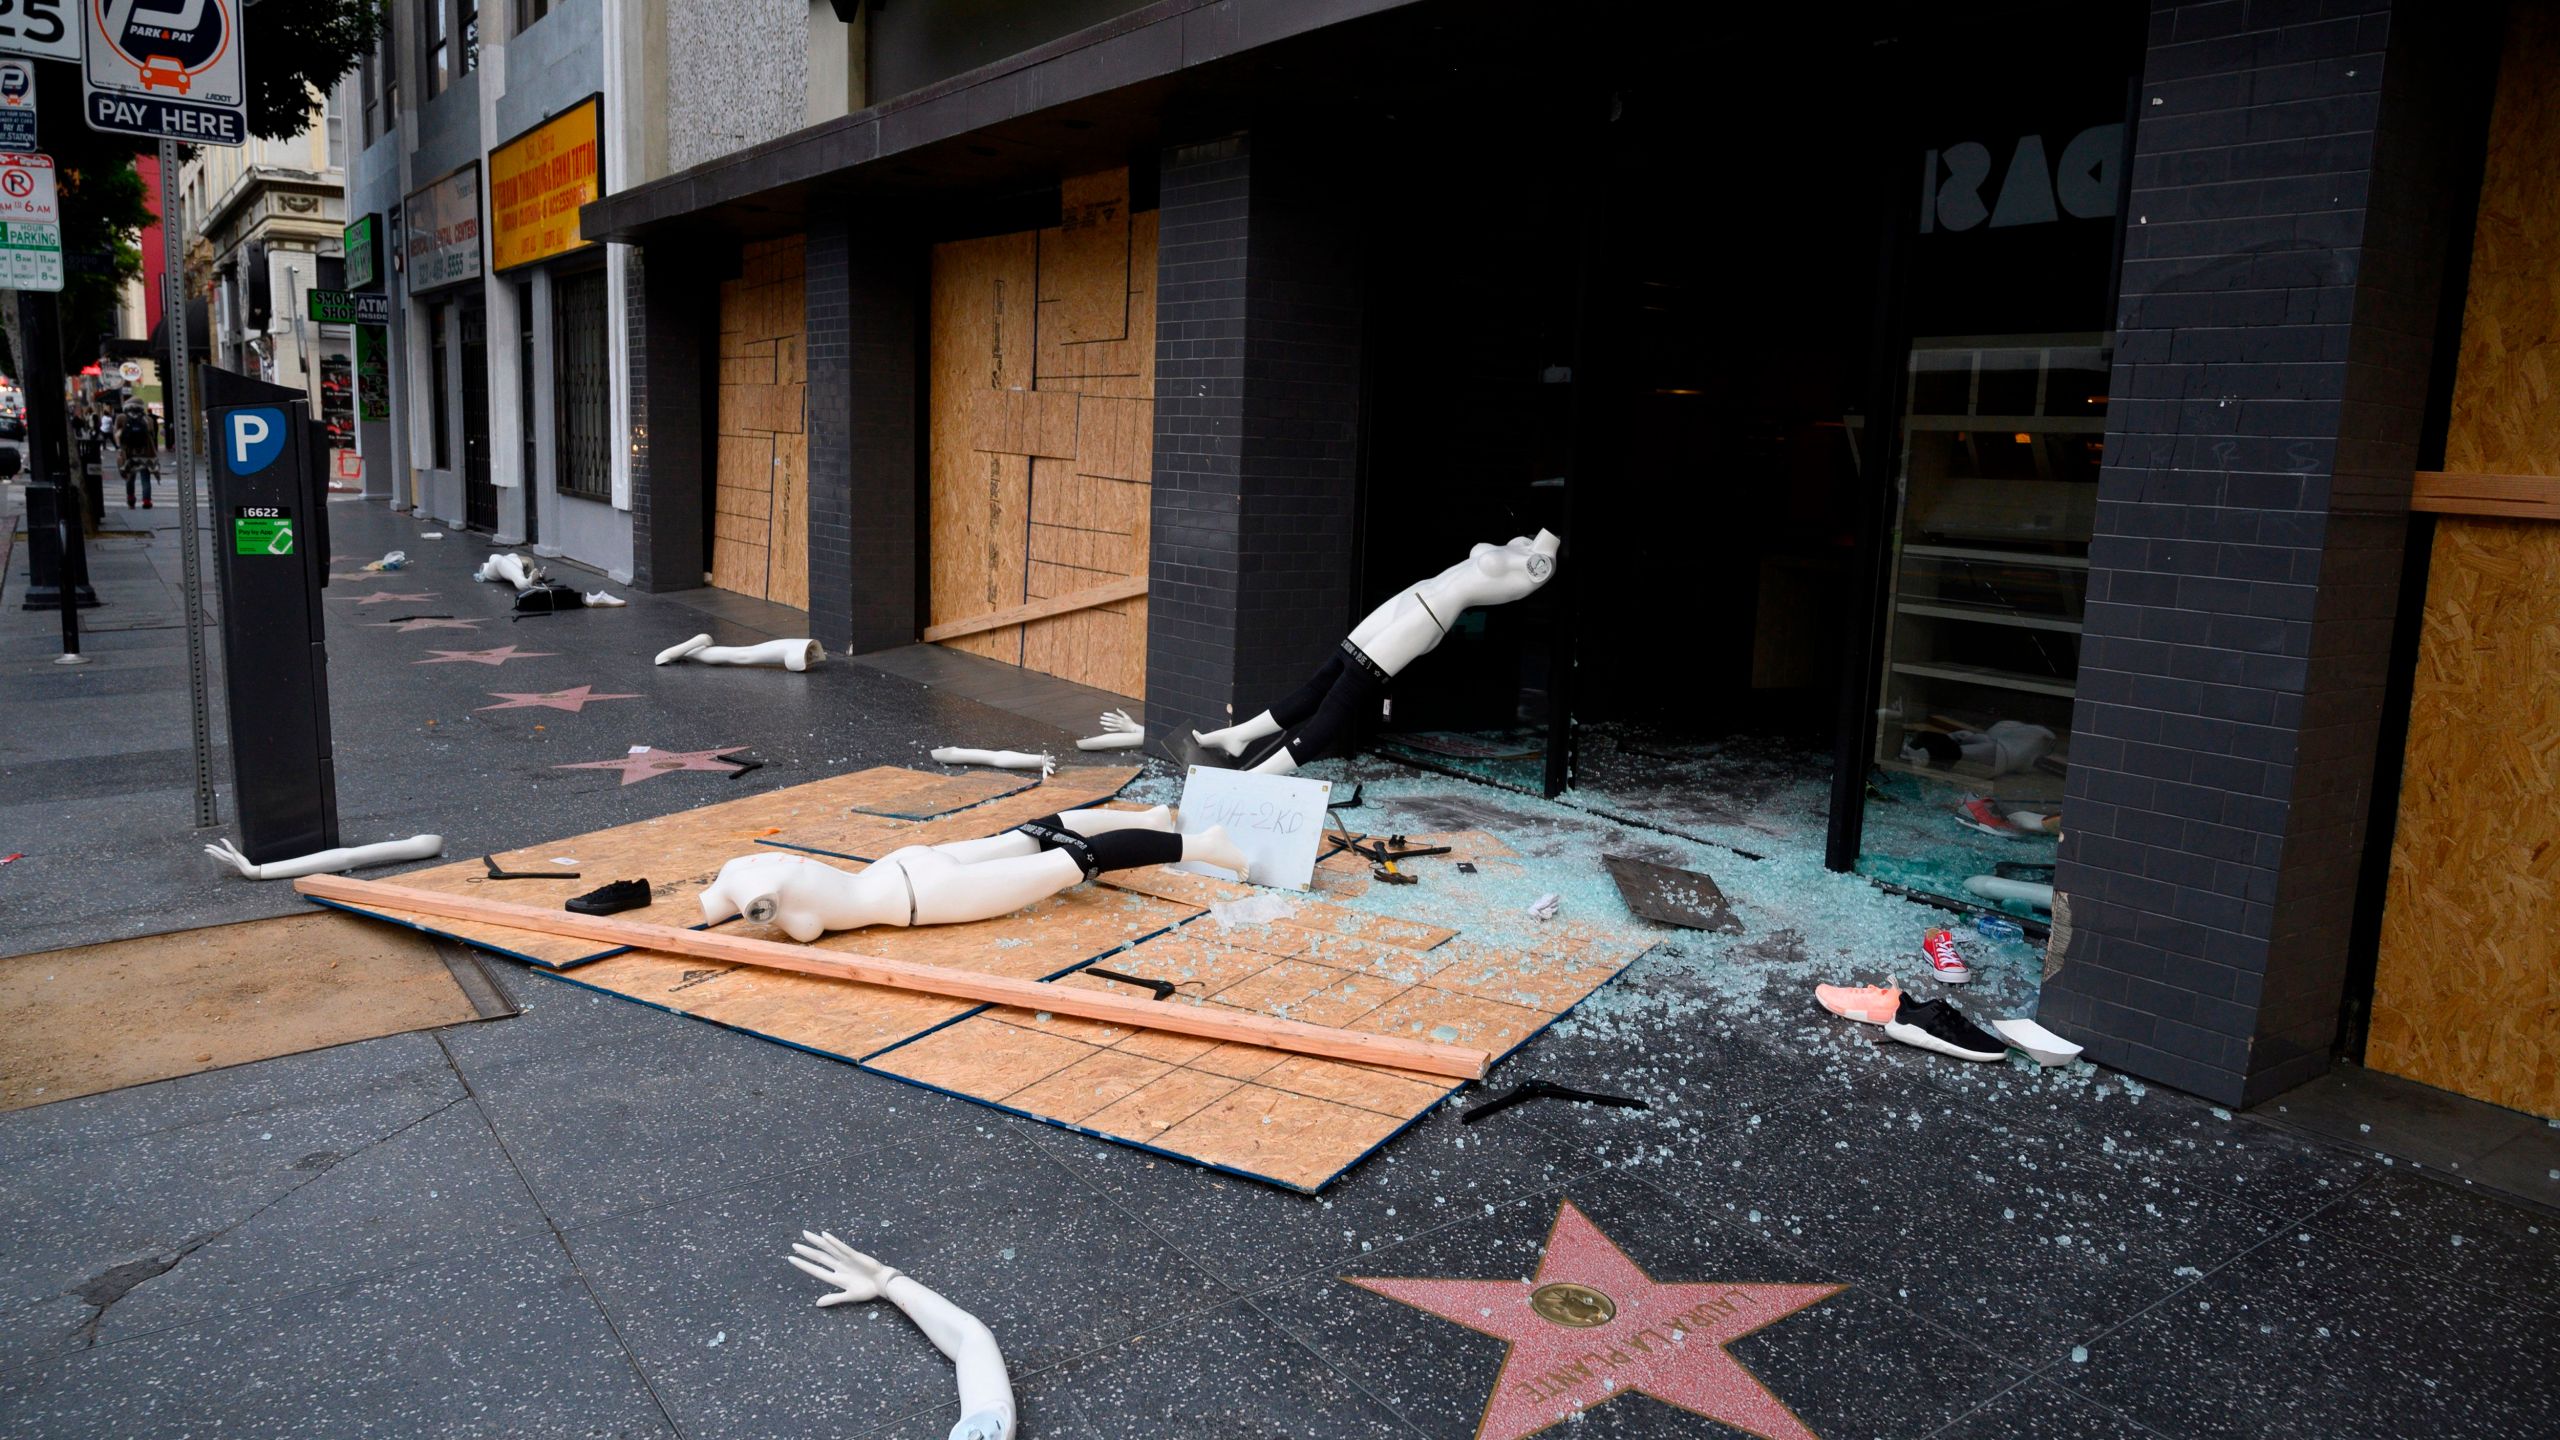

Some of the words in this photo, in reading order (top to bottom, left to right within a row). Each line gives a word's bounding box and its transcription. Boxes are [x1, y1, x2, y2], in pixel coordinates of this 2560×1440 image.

[129, 24, 161, 39] PARK
[171, 32, 195, 43] PAY
[98, 97, 148, 126] PAY
[161, 107, 236, 138] HERE
[571, 138, 596, 182] TATTOO
[24, 200, 34, 213] 6
[37, 205, 51, 214] AM
[10, 230, 56, 245] PARKING
[315, 292, 355, 307] SMOK
[358, 298, 388, 313] ATM
[322, 306, 356, 319] SHOP
[358, 312, 389, 321] INSIDE
[234, 414, 269, 462] P
[248, 507, 279, 518] 6622
[1662, 1289, 1757, 1335] LAURA
[1621, 1328, 1675, 1354] LA
[1516, 1346, 1632, 1404] PLANTE
